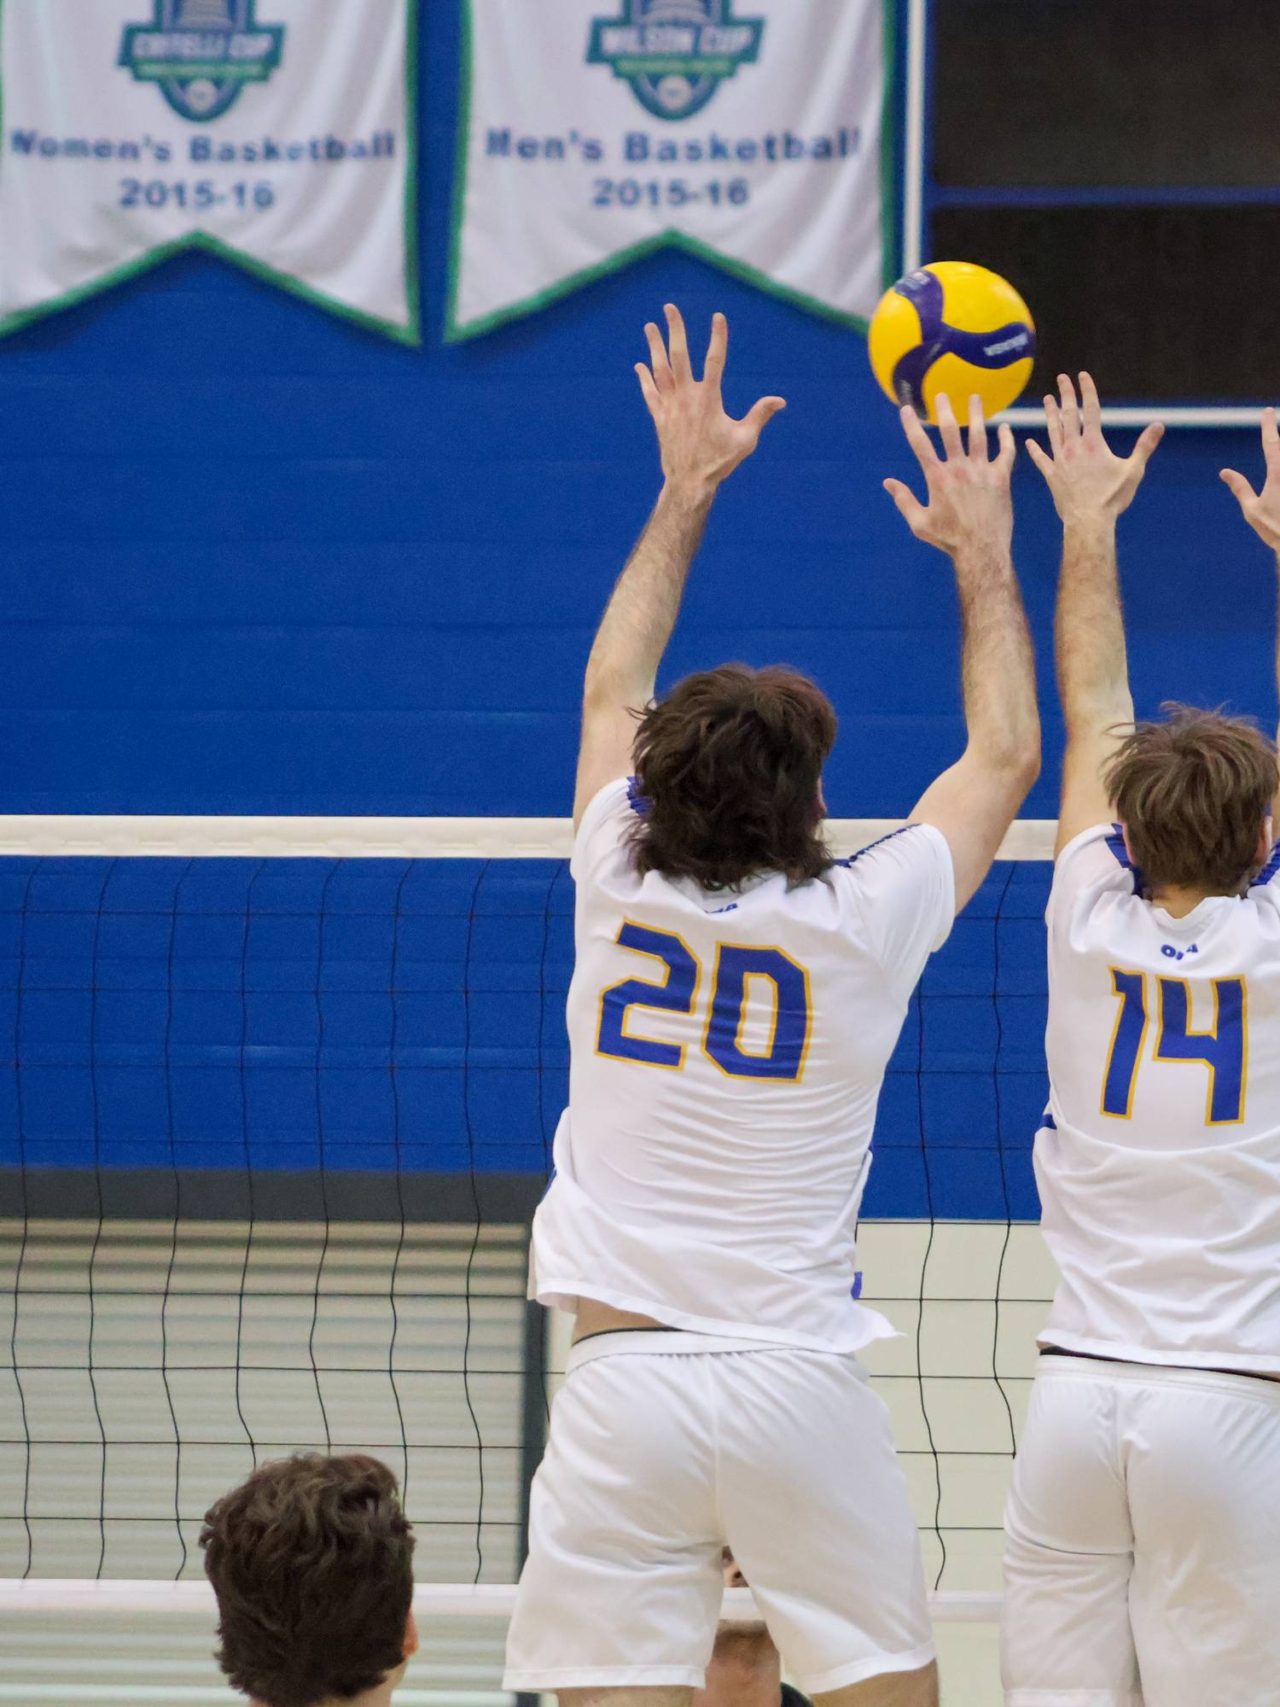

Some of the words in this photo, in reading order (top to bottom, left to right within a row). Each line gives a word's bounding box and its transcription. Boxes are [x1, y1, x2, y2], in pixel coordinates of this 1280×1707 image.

[11, 129, 172, 161] Women's
[189, 130, 396, 163] Basketball
[484, 127, 602, 161] Men's
[119, 178, 276, 209] 2015-16
[591, 178, 751, 208] 2015-16
[594, 915, 814, 1085] 20
[1099, 964, 1248, 1127] 14
